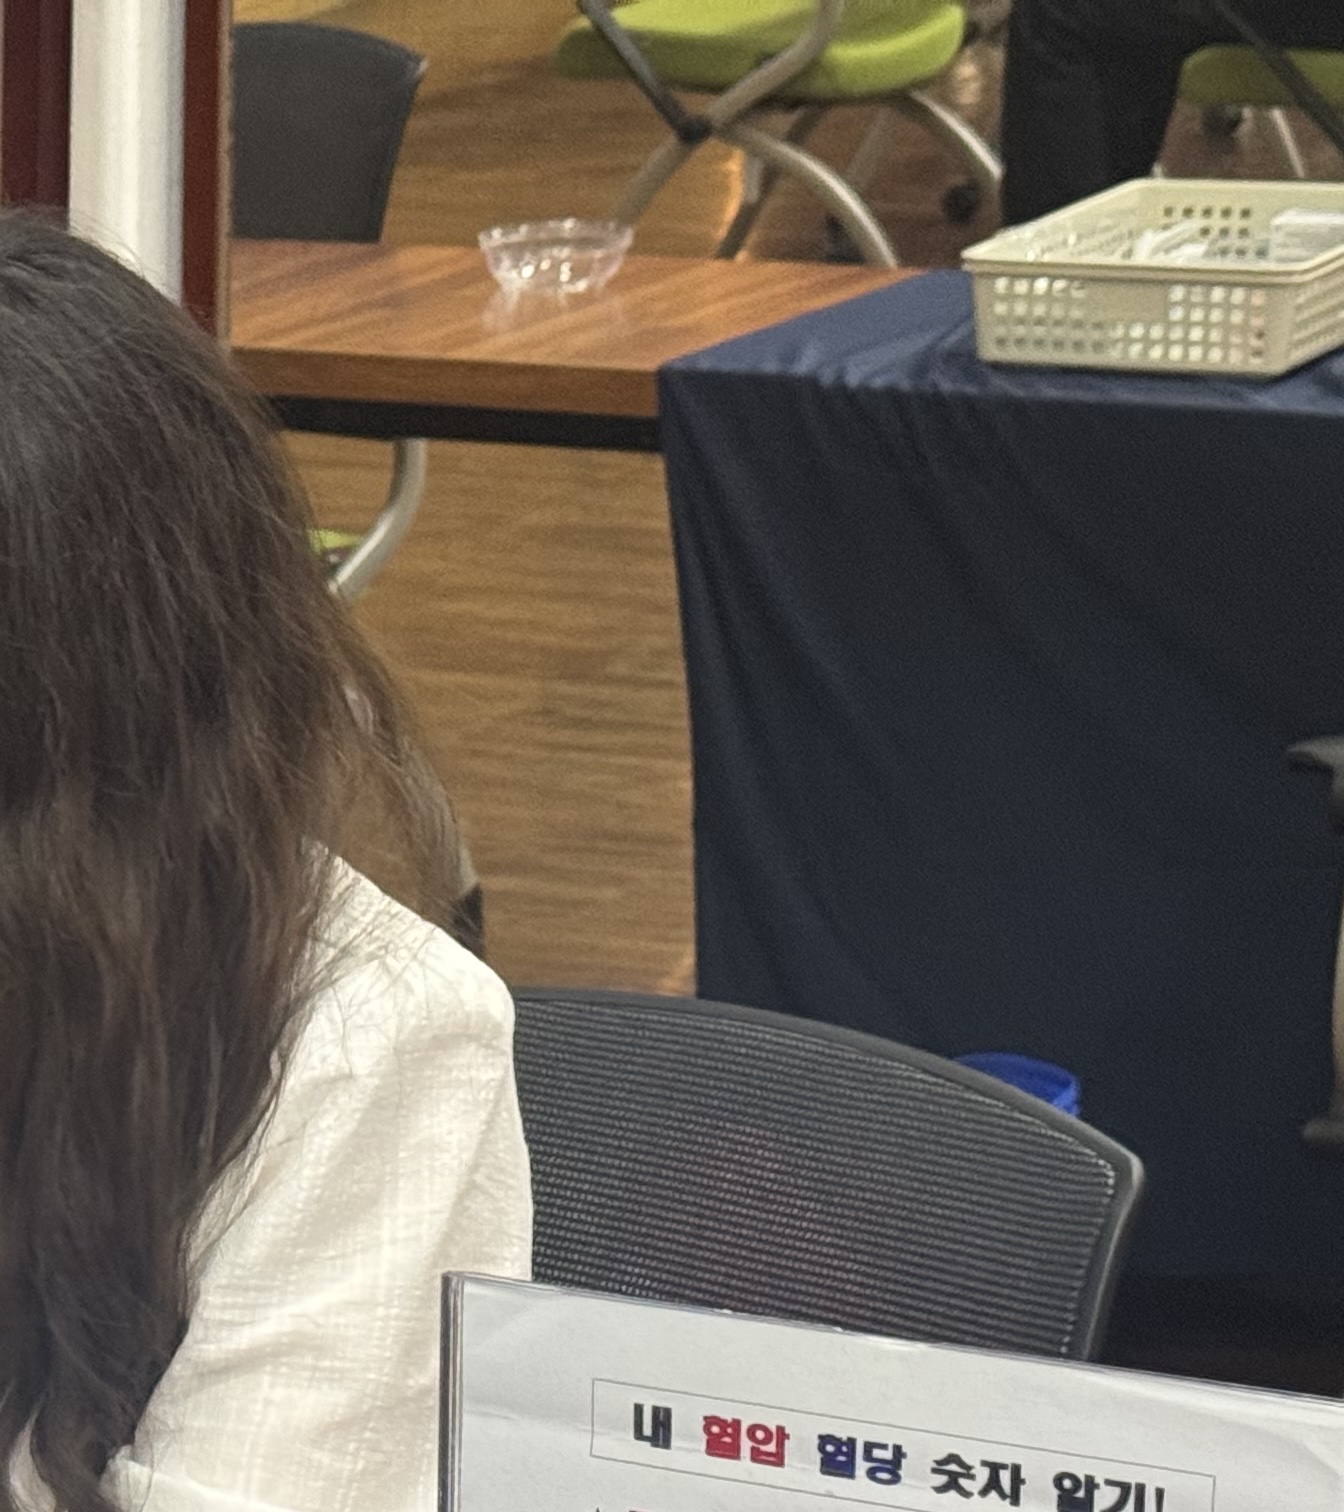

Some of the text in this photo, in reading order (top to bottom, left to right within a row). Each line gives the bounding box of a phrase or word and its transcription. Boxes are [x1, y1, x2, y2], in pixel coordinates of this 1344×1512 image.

[633, 1402, 672, 1450] 내
[702, 1414, 790, 1469] 혈압
[817, 1433, 908, 1486] 혈당
[930, 1452, 1026, 1507] 숫자
